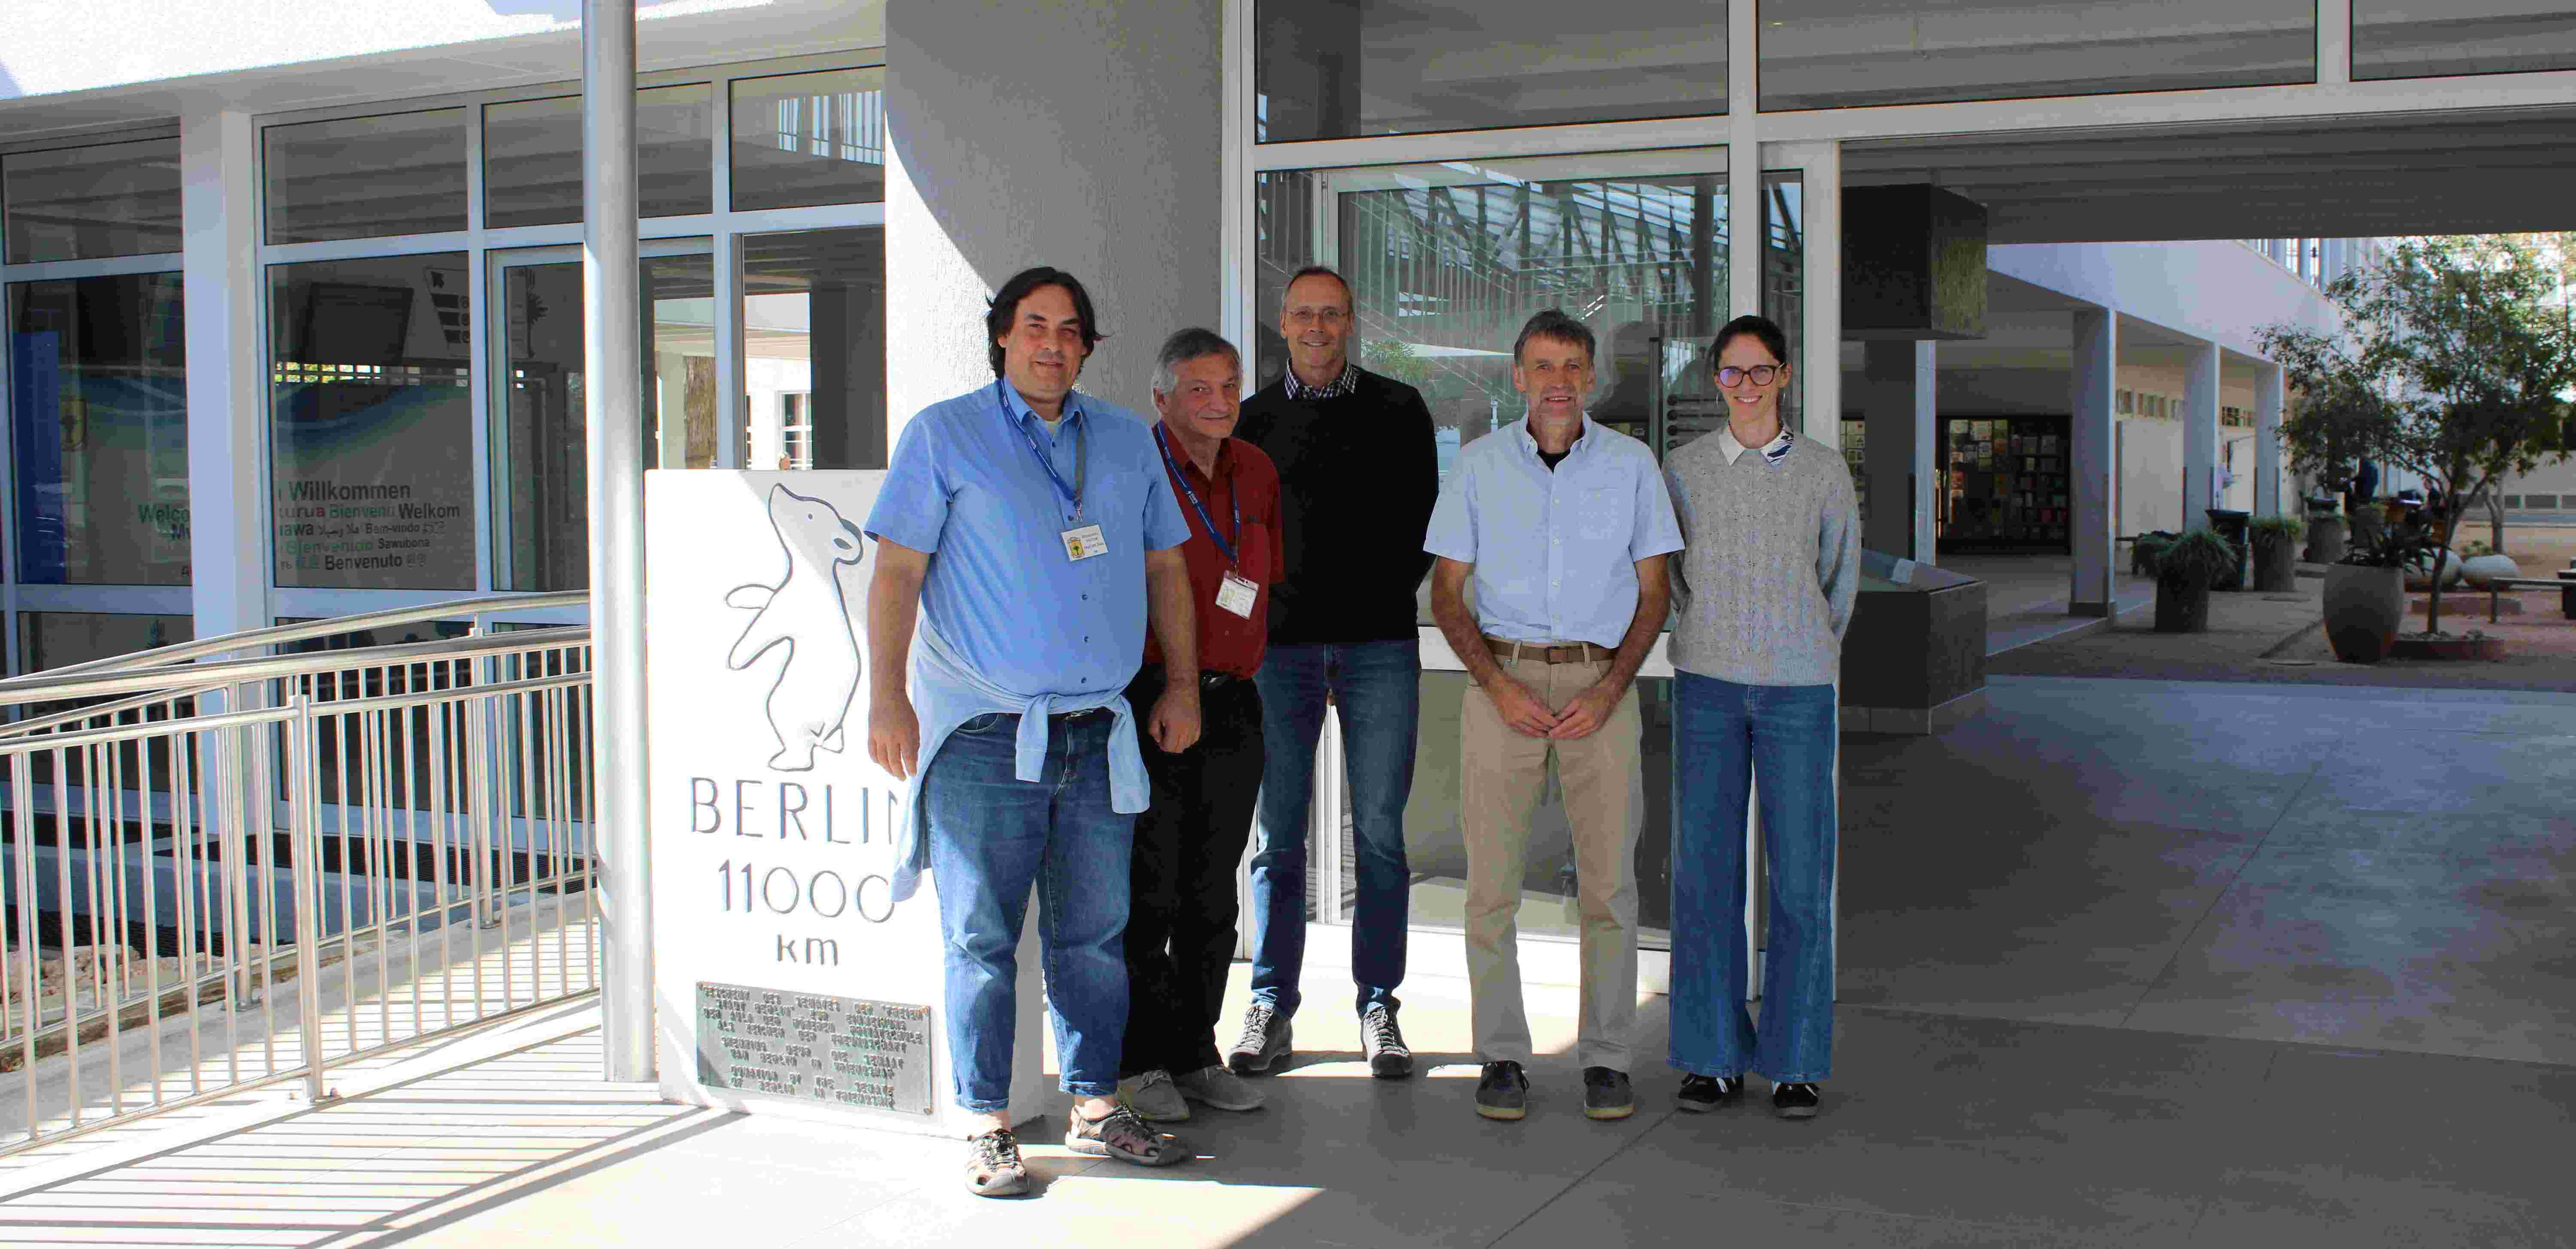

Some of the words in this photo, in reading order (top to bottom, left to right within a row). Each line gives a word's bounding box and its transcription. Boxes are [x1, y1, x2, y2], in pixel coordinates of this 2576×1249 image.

[289, 480, 411, 500] Willkommen
[398, 502, 460, 519] Welkom
[366, 522, 419, 534] Bem-vindo
[378, 537, 430, 550] Sawubona
[325, 555, 403, 570] Benvenuto
[718, 858, 895, 924] 11000
